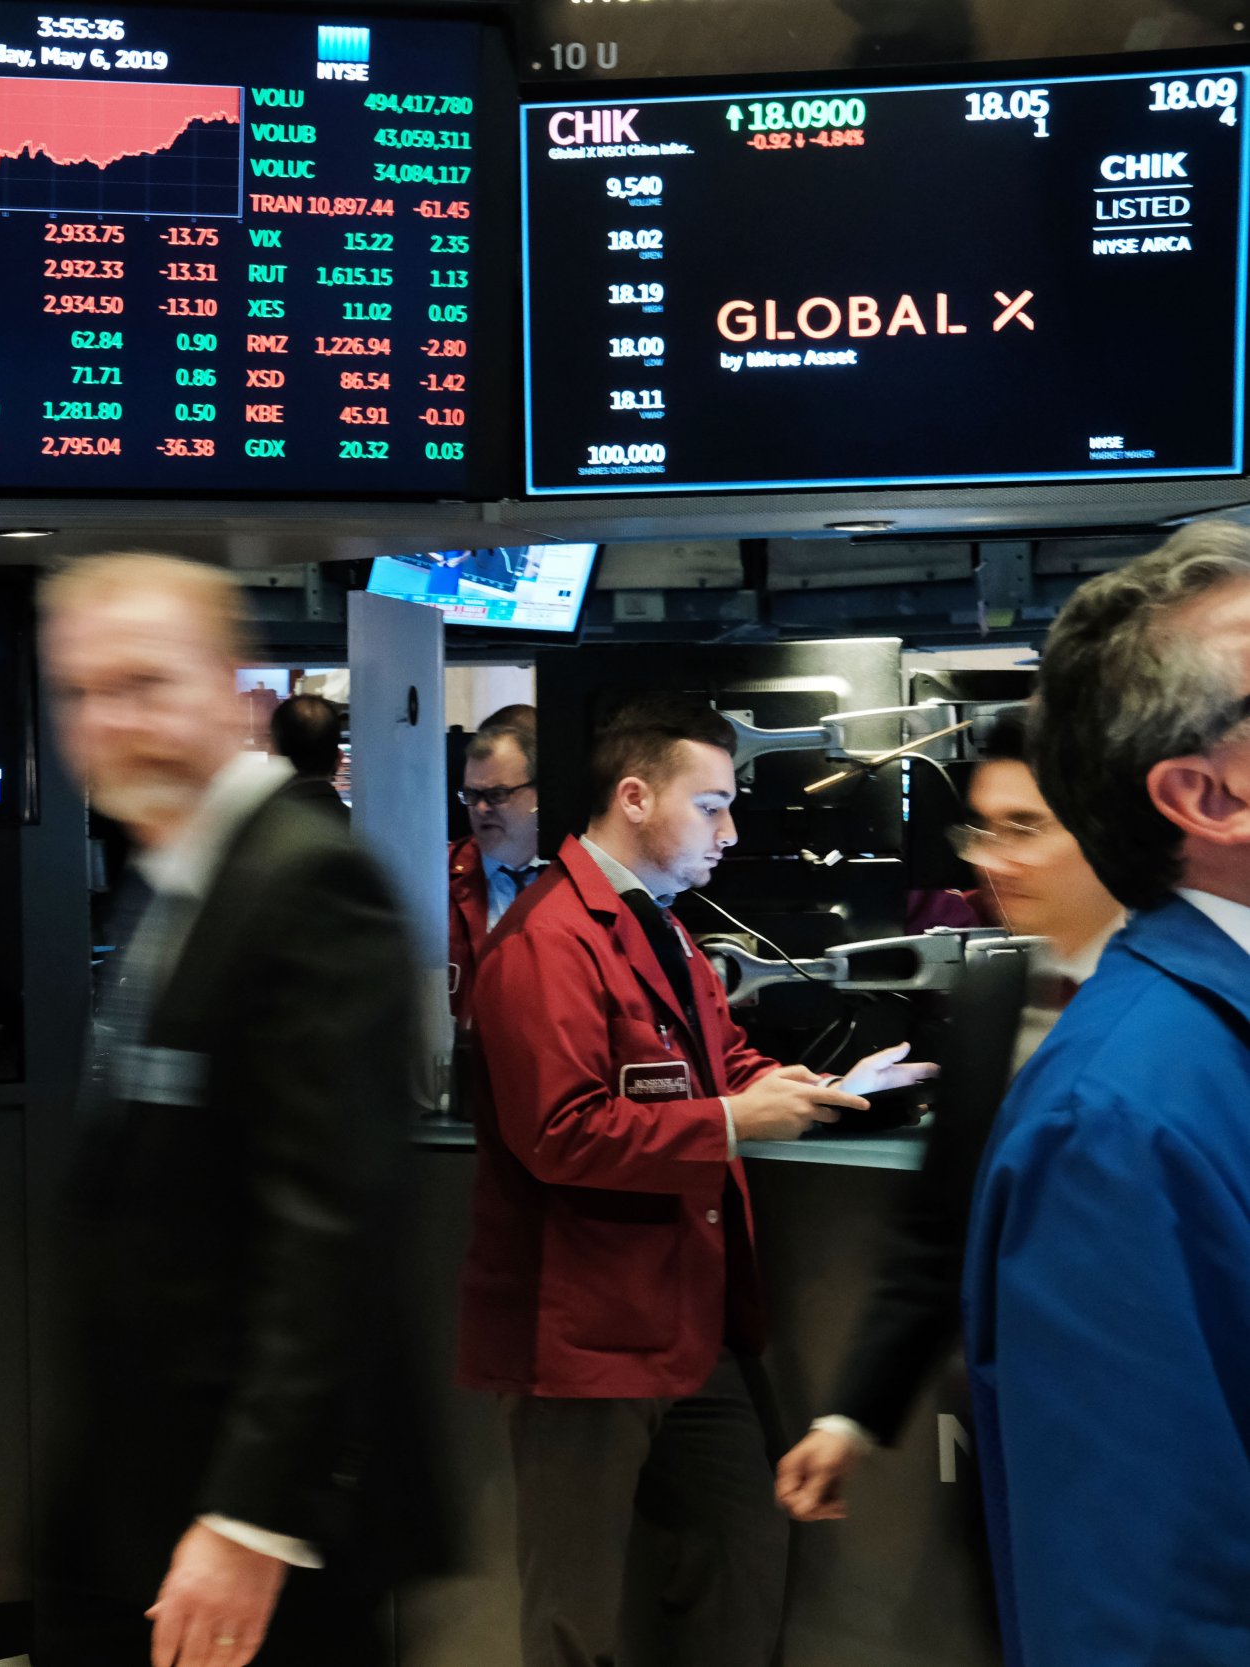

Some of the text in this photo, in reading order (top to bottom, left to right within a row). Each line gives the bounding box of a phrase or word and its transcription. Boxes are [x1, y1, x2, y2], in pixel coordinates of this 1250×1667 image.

[37, 16, 125, 40] 3:55:36
[41, 46, 86, 69] May
[89, 48, 111, 71] 6,
[115, 50, 168, 70] 2019
[550, 41, 618, 71] 10 U
[316, 62, 370, 82] NYSE
[252, 88, 473, 115] VOLU 494,417,780
[965, 89, 1050, 121] 18.05
[1149, 77, 1238, 111] 18.09
[748, 98, 866, 131] 18.0900
[1219, 106, 1237, 126] 4
[251, 123, 471, 150] VOLUB 43,059,311
[549, 108, 639, 145] CHIK
[1034, 117, 1050, 137] 1
[747, 132, 792, 150] -0.92
[250, 159, 471, 185] VOLUC 34,084,117
[1100, 152, 1188, 181] CHIK
[606, 175, 663, 199] 9,540
[249, 193, 470, 219] TRAN 10,897.44 -61.45
[1096, 195, 1190, 219] LISTED
[45, 224, 124, 243] 2,933.75
[160, 228, 218, 246] -13.75
[249, 230, 469, 253] VIX 15.22 2.35
[607, 229, 663, 251] 18.02
[1093, 235, 1192, 255] NYSE ARCA
[44, 259, 124, 279] 2,932.33
[159, 263, 218, 281] -13.31
[249, 264, 468, 288] RUT 1,615.15 1.13
[608, 283, 664, 304] 18.19
[44, 295, 123, 314] 2,934.50
[159, 298, 217, 316] -13.10
[248, 300, 467, 322] XES 11.02 0.05
[717, 290, 1034, 342] GLOBAL X
[71, 331, 123, 349] 62.84
[177, 333, 217, 351] 0.90
[247, 335, 466, 357] RMZ 1,226.94 -2.80
[608, 336, 665, 357] 18.00
[720, 349, 857, 372] by Mirae Asset
[71, 367, 122, 384] 71.71
[176, 368, 216, 386] 0.86
[246, 370, 465, 391] XSD 86.54 -1.42
[609, 389, 665, 410] 18.11
[43, 402, 122, 421] 1,281.80
[175, 404, 215, 421] 0.50
[246, 405, 464, 425] KBE 45.91 -0.10
[42, 437, 121, 456] 2,795.04
[157, 439, 214, 456] -36.38
[245, 439, 464, 460] GDX 20.32 0.03
[587, 444, 666, 466] 100,000
